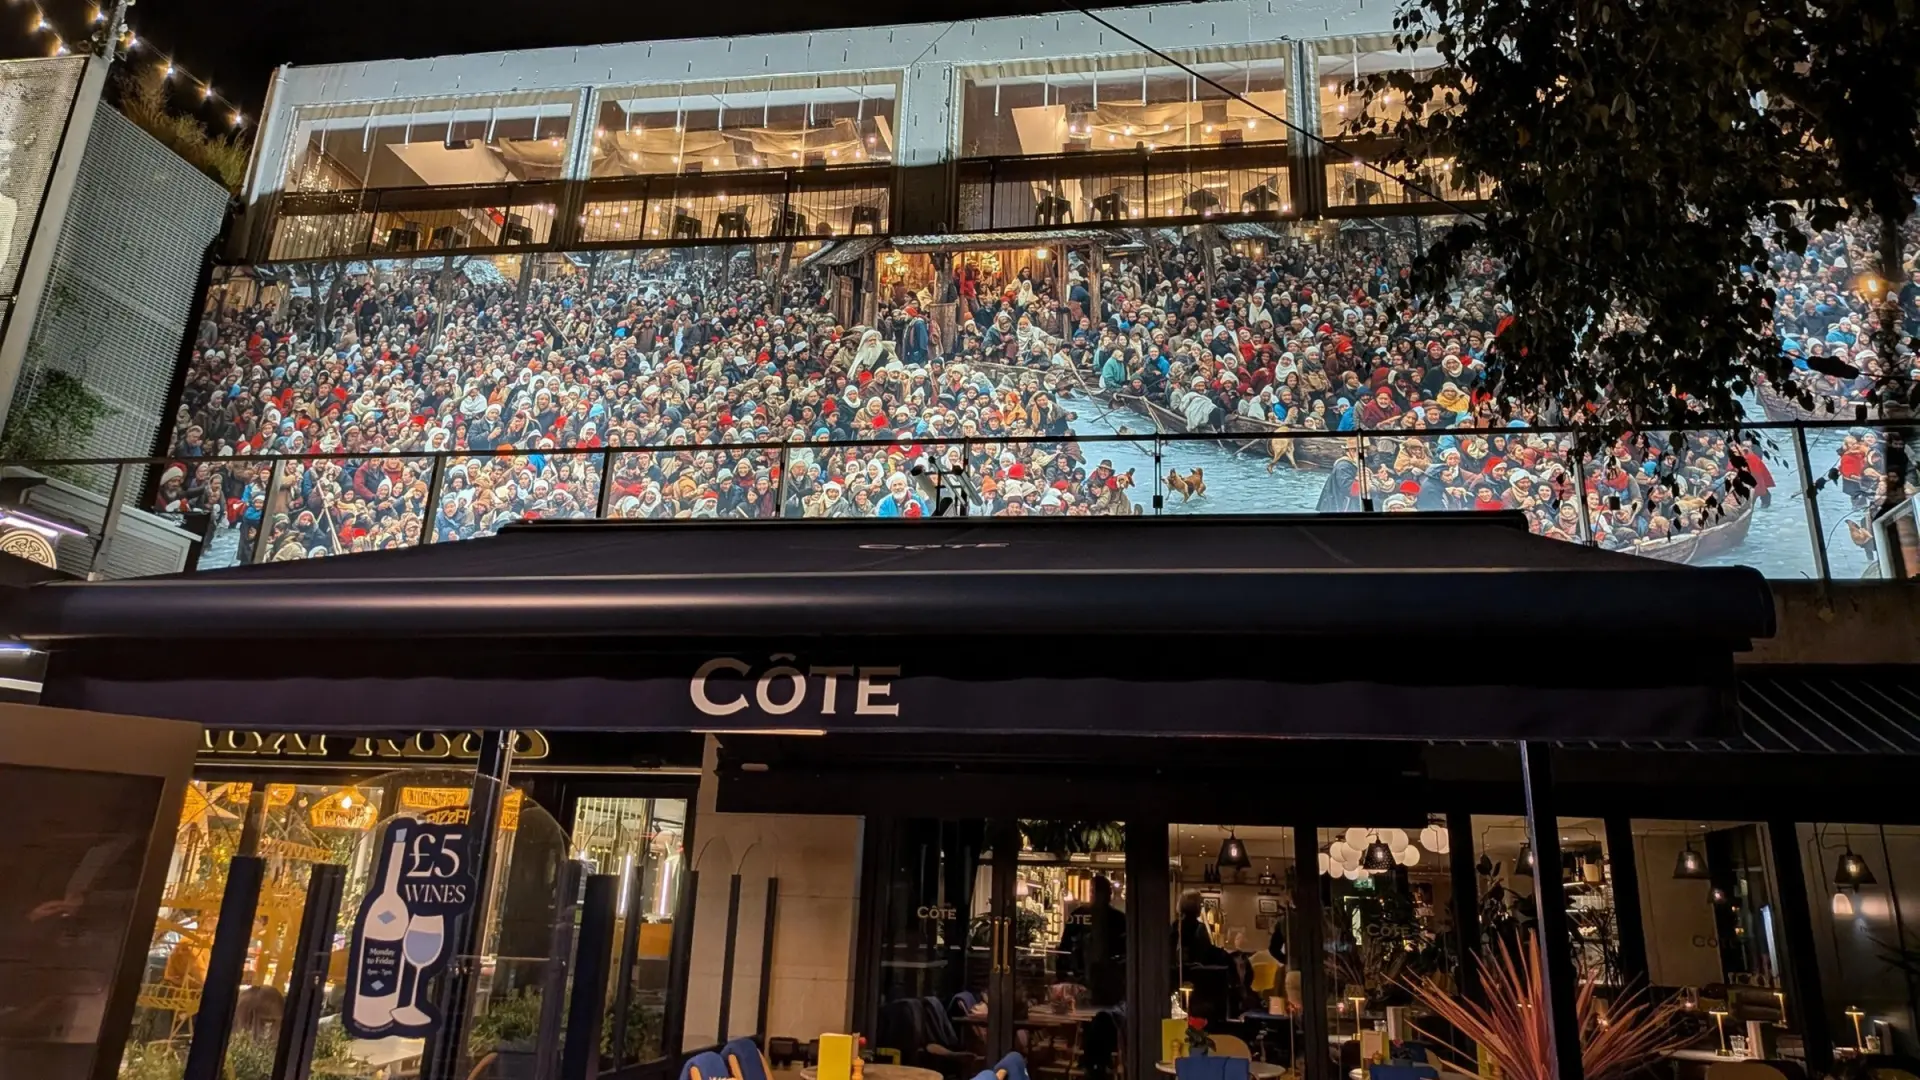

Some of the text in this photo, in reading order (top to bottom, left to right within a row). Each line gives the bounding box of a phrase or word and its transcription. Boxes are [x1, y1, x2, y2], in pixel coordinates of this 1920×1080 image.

[690, 653, 901, 716] CÔTE
[406, 833, 462, 878] £5
[405, 884, 466, 903] WINES
[917, 904, 957, 920] CÔTE
[369, 948, 395, 956] Monday
[375, 957, 395, 966] Friday
